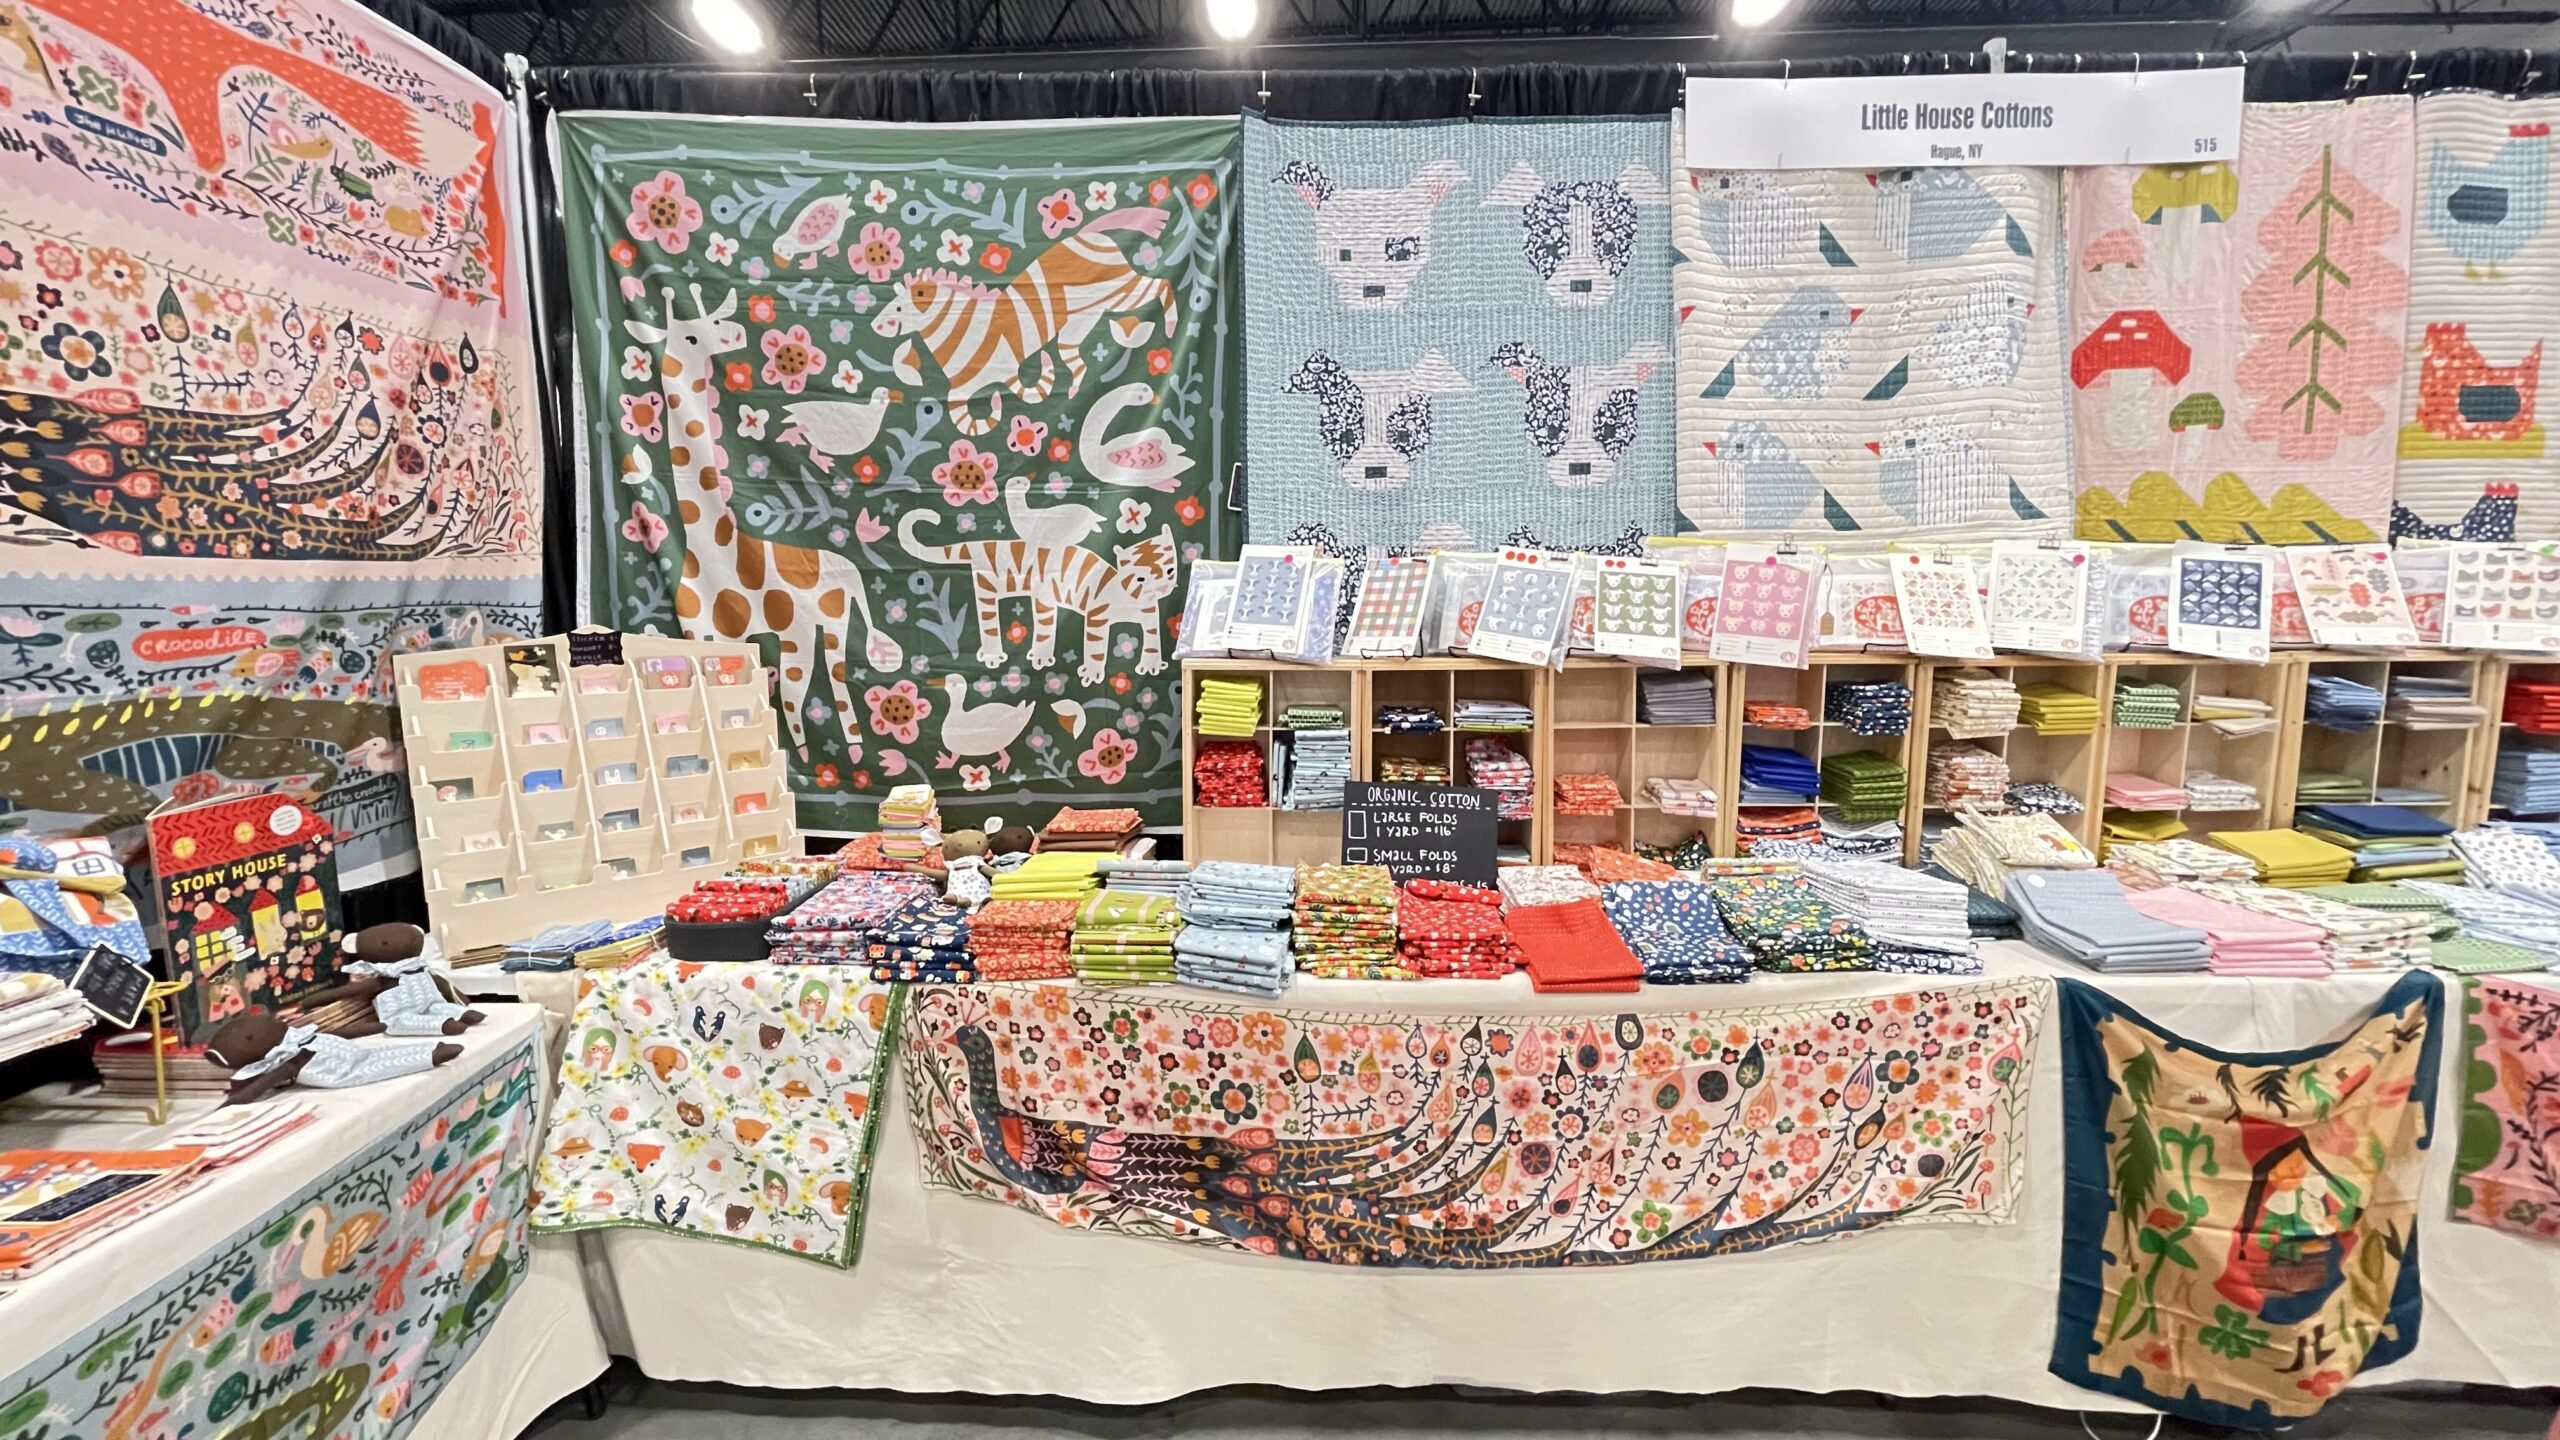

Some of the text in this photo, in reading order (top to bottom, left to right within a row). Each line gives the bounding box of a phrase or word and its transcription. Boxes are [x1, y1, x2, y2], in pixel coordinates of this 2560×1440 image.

[1861, 101, 2055, 131] Little House Cottons
[1930, 144, 1983, 161] Hague, NY
[2194, 138, 2218, 154] 515
[1429, 791, 1481, 807] COTTON
[1419, 812, 1458, 826] FOLDS
[1419, 849, 1458, 862] FOLDS
[171, 853, 288, 897] STORY HOUSE
